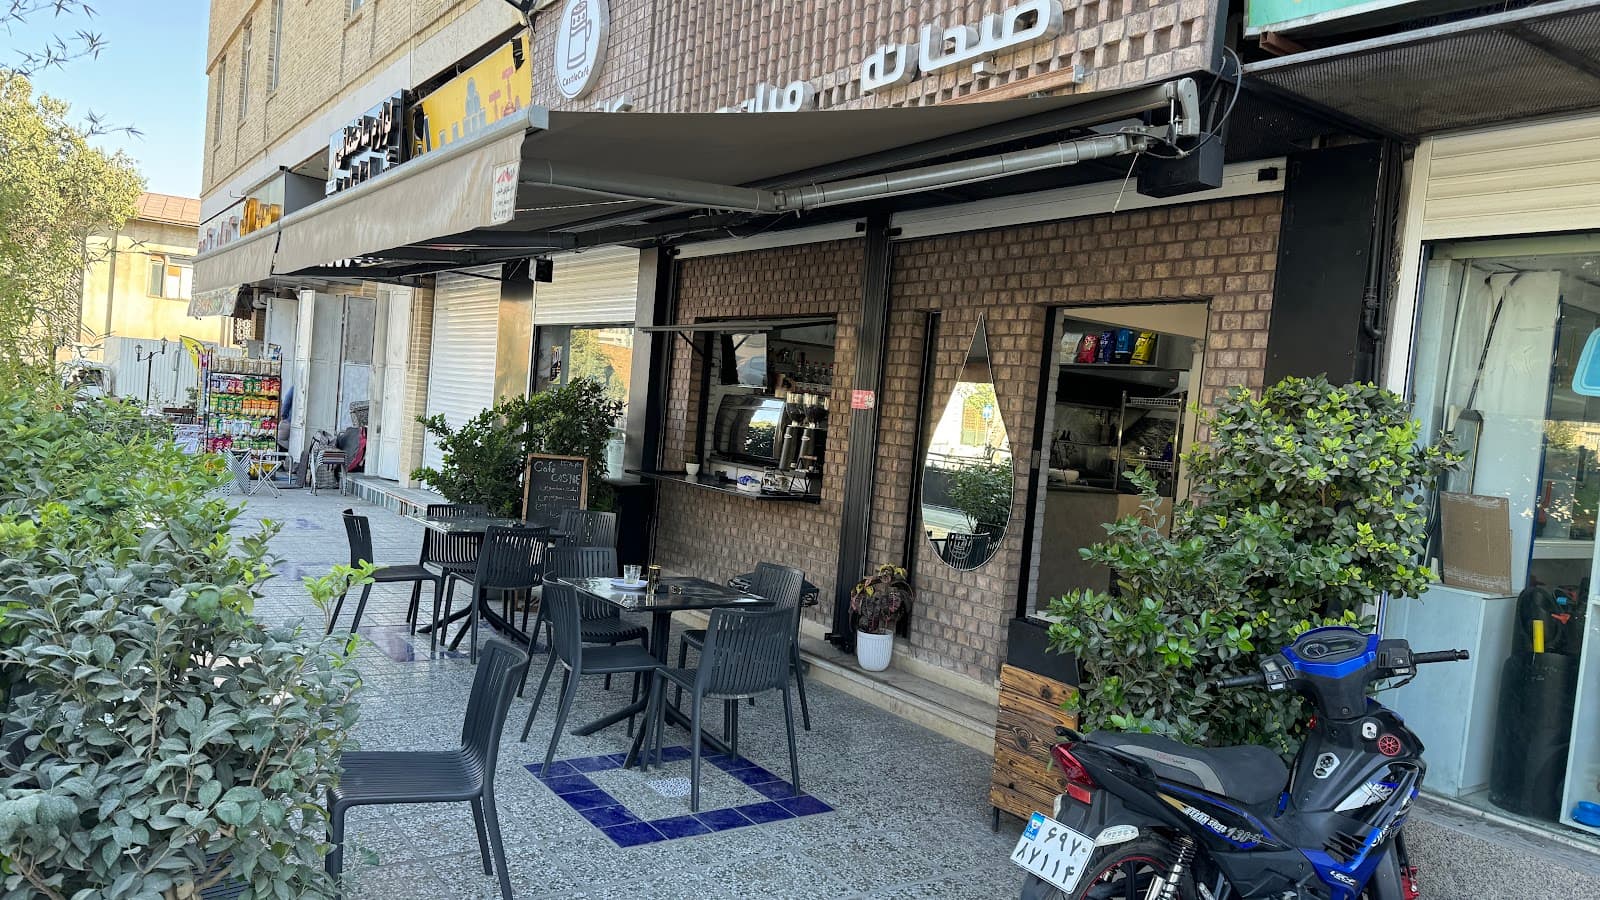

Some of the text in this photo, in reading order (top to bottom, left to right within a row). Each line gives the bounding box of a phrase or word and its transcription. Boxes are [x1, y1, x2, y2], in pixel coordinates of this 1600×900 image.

[861, 0, 1060, 92] صبحانه
[1016, 842, 1075, 884] ۸۷۱۱۴
[1044, 827, 1082, 857] ۶۹۷
